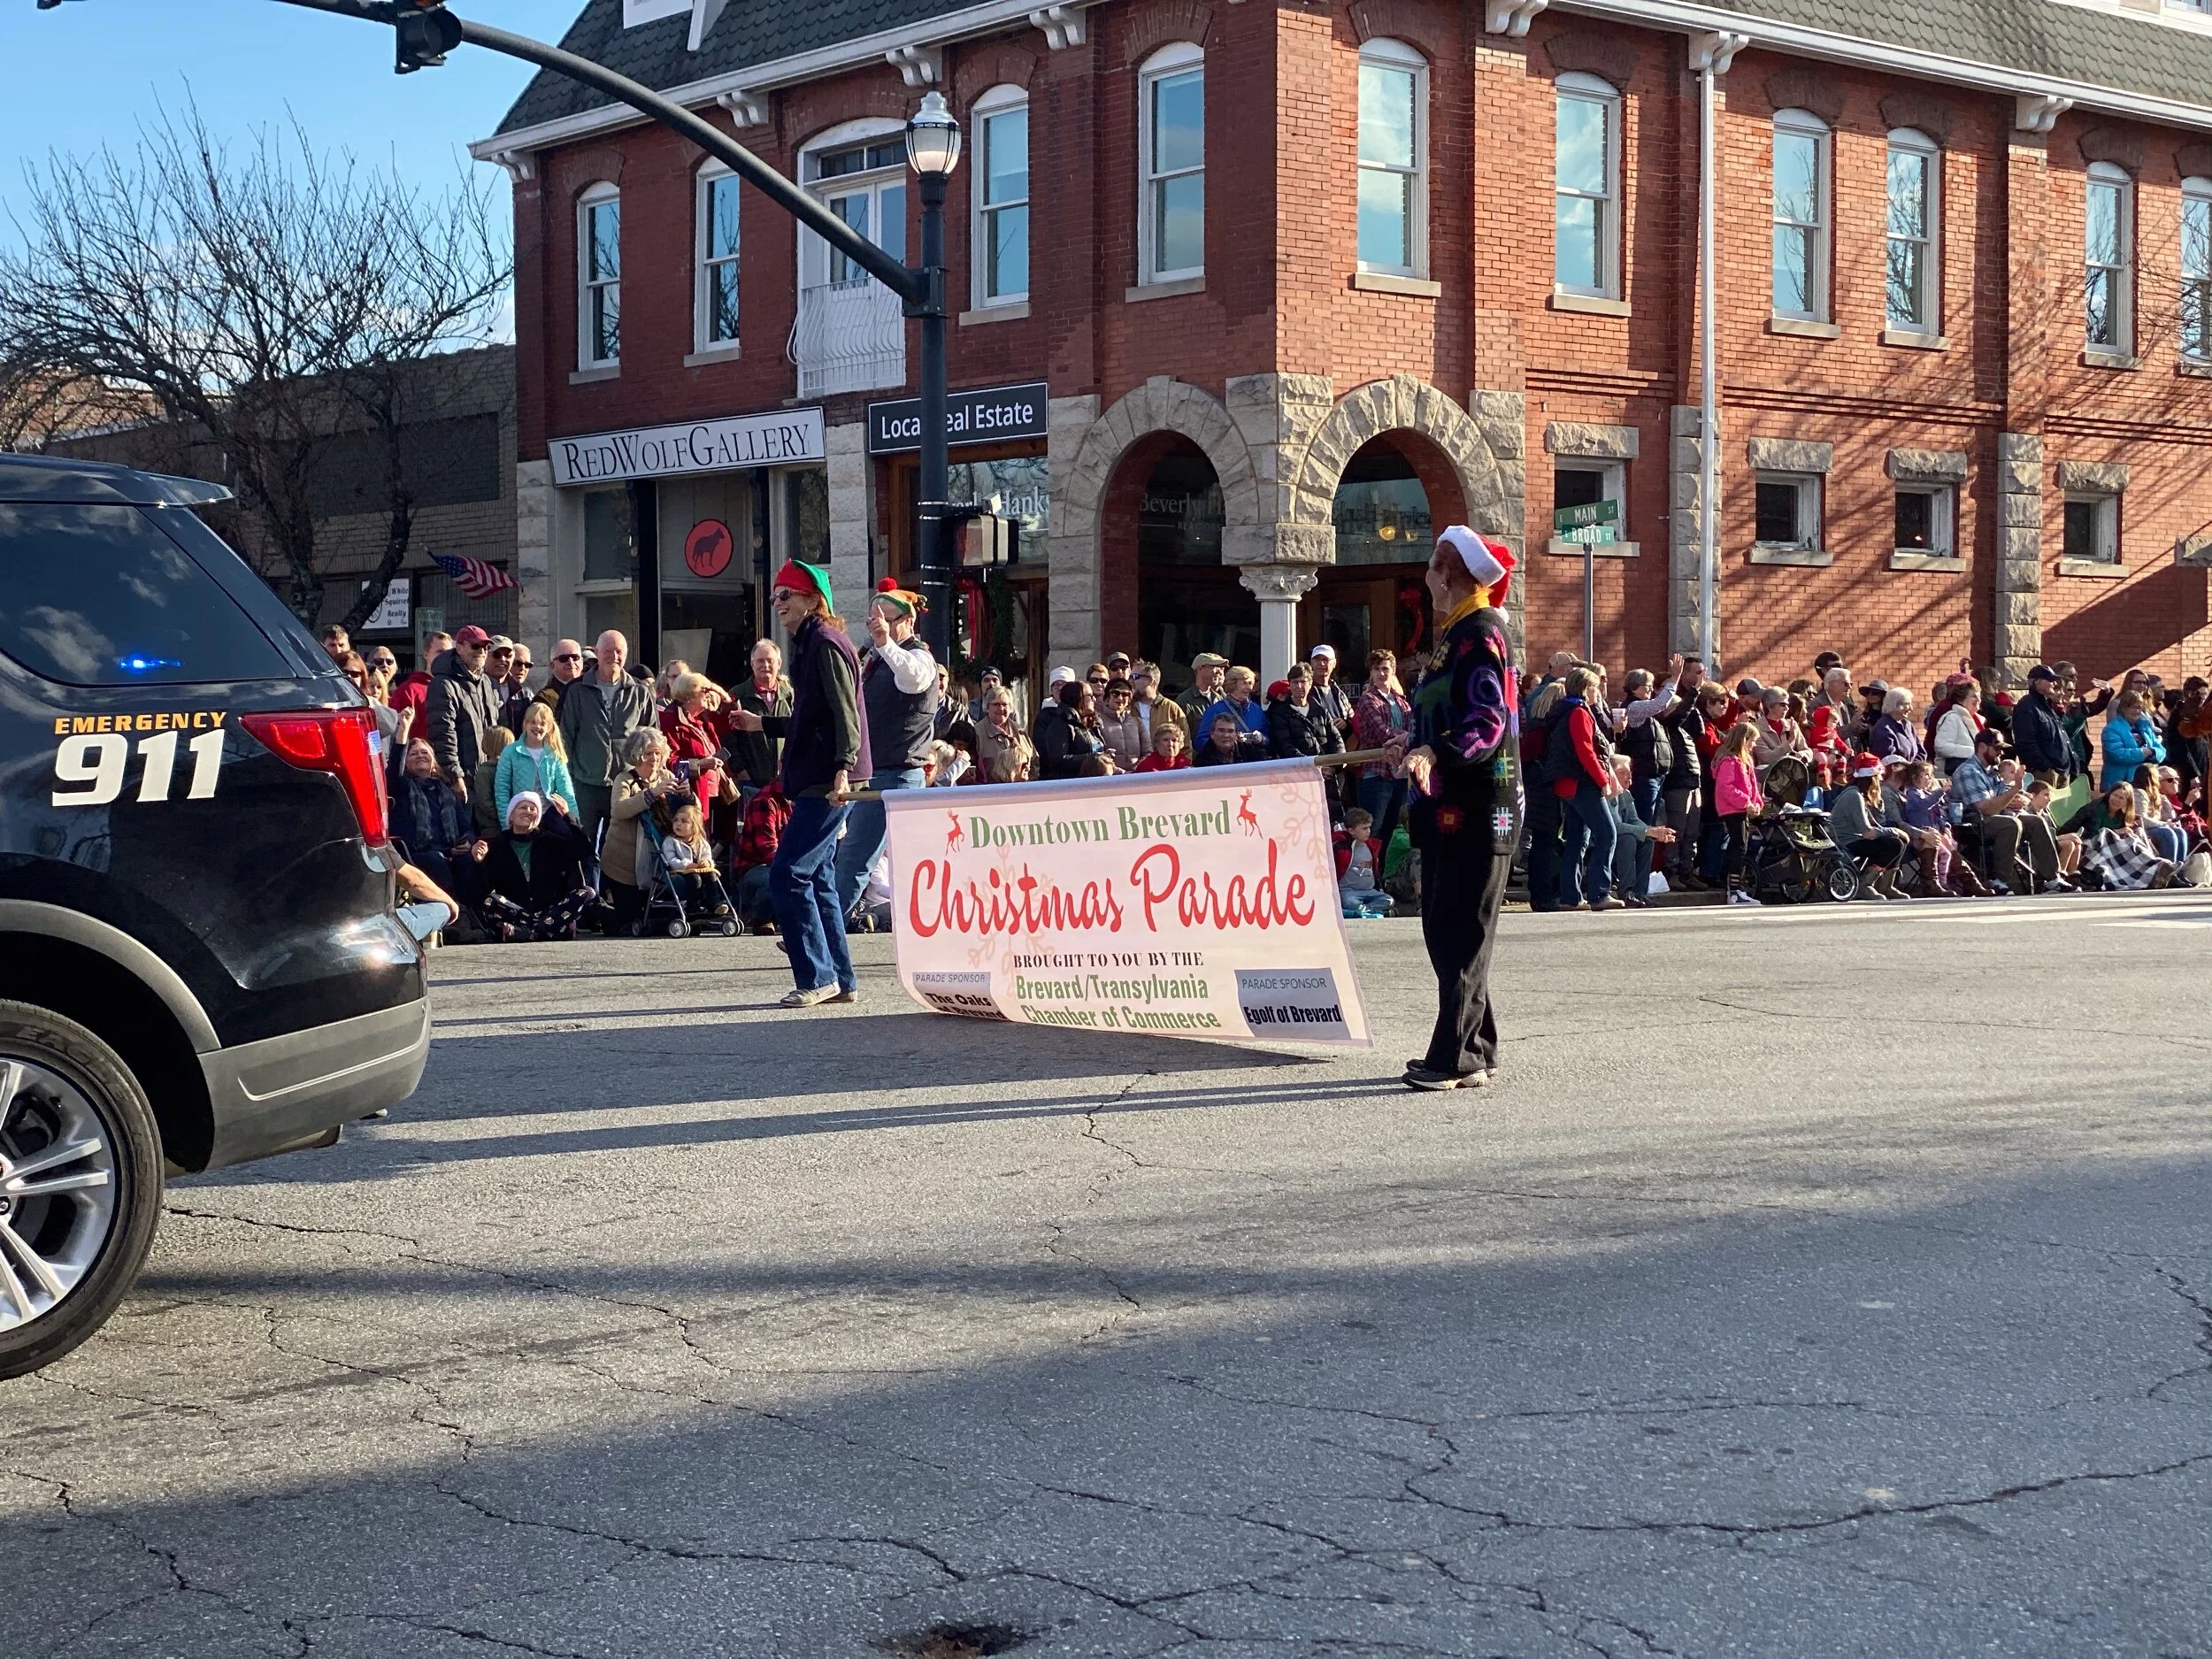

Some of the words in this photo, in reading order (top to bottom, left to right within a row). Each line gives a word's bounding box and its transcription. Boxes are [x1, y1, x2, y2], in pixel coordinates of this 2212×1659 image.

[882, 416, 921, 439] Loca
[946, 404, 970, 432] eal
[975, 402, 1033, 429] Estate
[1574, 505, 1598, 524] MAIN
[1571, 527, 1601, 543] BROAD
[54, 711, 227, 734] EMERGENCY
[51, 728, 226, 807] 911
[969, 813, 1110, 849] Downtown
[1117, 799, 1232, 840] Brevard
[910, 859, 1125, 938] Christmas
[1130, 838, 1316, 933] Parade
[1013, 954, 1084, 968] BROUGHT
[1087, 954, 1107, 967] TO
[1111, 953, 1143, 967] YOU
[1148, 952, 1168, 966] BY
[1171, 952, 1204, 966] THE
[915, 974, 946, 983] PARADE
[1016, 973, 1210, 1005] Brevard/Transylvania
[1241, 979, 1277, 989] PARADE
[1279, 978, 1327, 989] SPONSOR
[925, 992, 955, 1004] The
[955, 994, 992, 1007] Oaks
[1021, 1004, 1098, 1026] Chamber
[1102, 1006, 1121, 1027] of
[1120, 1005, 1222, 1029] Commerce
[1243, 1006, 1277, 1025] Egolf
[1276, 1006, 1291, 1023] of
[1288, 1004, 1343, 1023] Brevard
